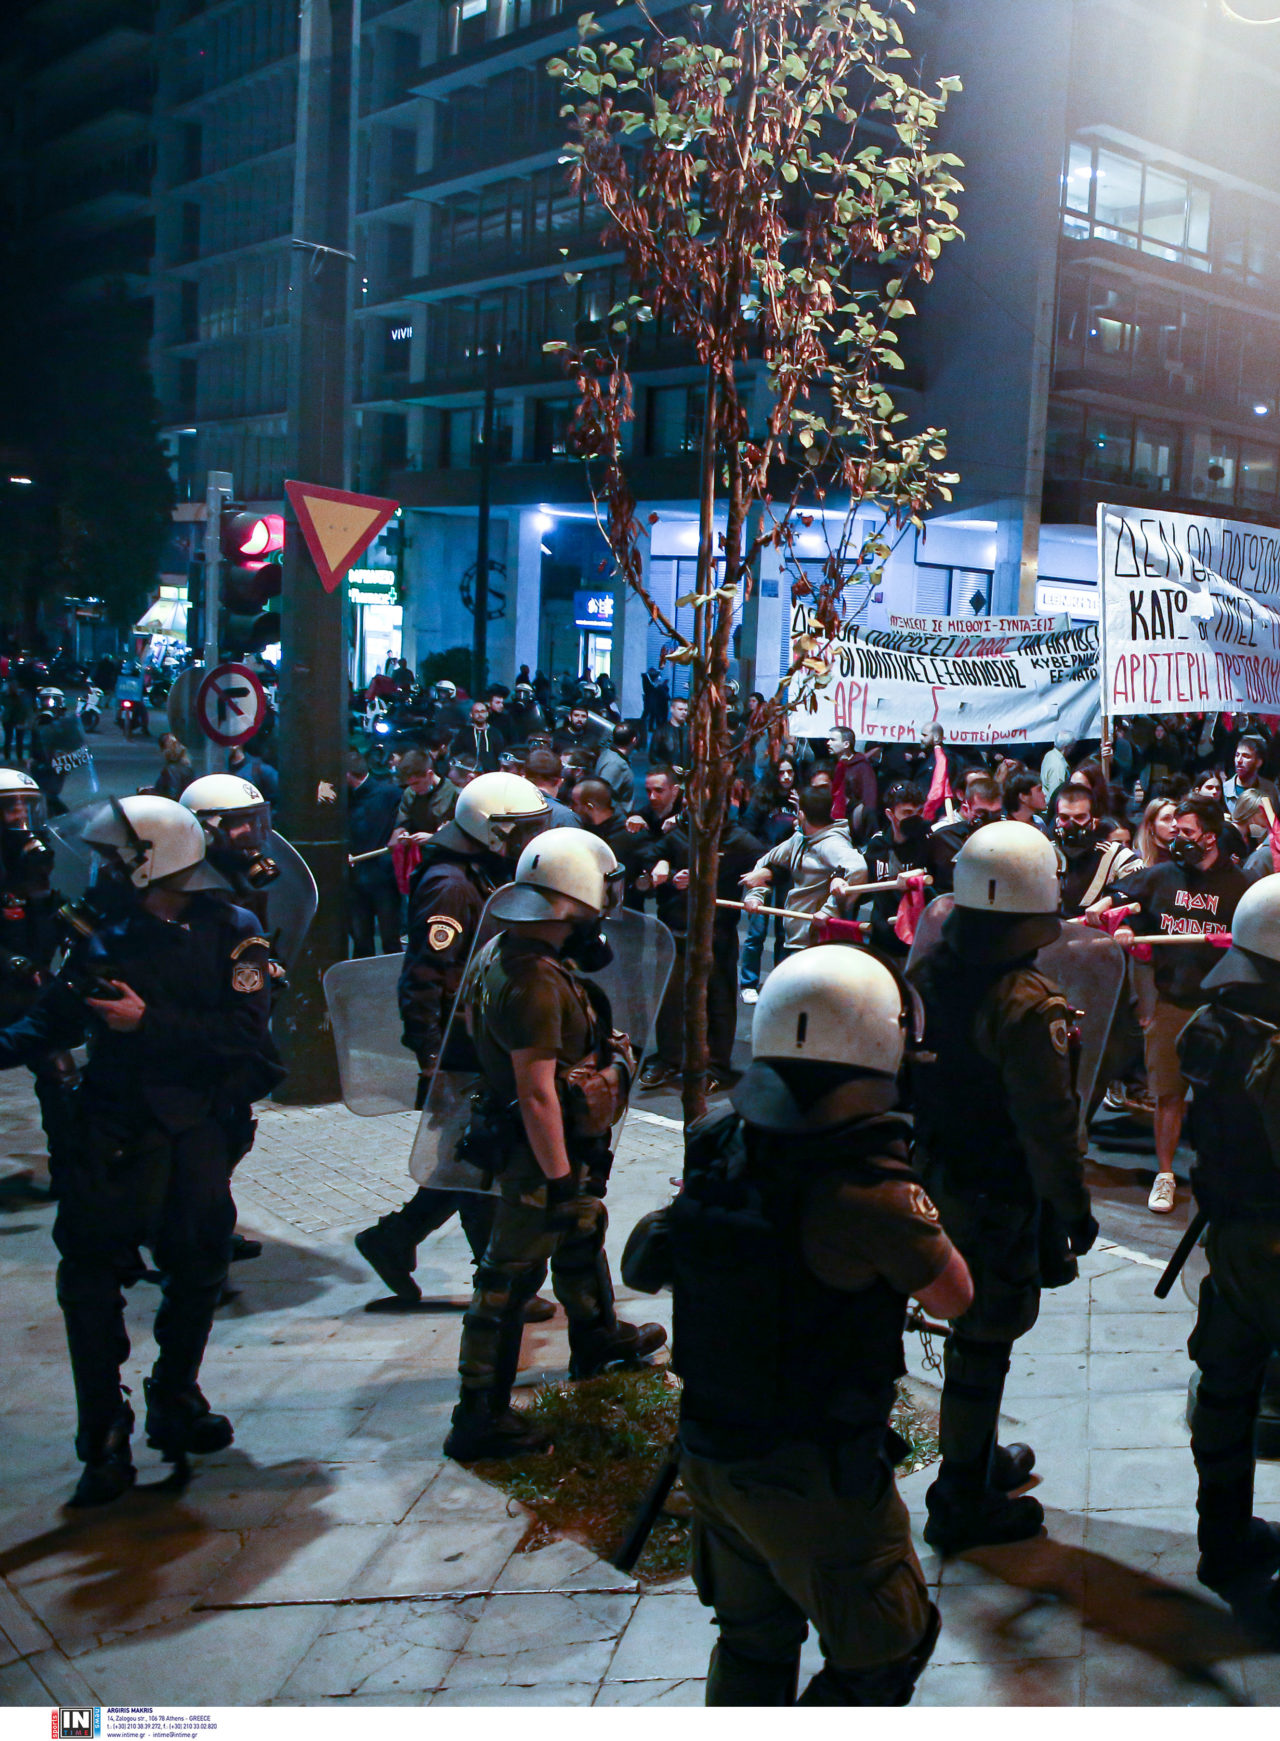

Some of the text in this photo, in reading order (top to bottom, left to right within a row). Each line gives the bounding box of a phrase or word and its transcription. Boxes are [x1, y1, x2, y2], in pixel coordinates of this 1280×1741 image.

[1114, 517, 1184, 578] ΔΕΝ
[1187, 524, 1218, 582] ΘΑ
[932, 619, 943, 633] ΣΕ
[1129, 588, 1190, 641] ΚΑΤΩ
[1210, 592, 1258, 648] ΤΙΜΕΣ
[865, 629, 957, 658] ΠΛΗΡΩΣΕΙ
[1045, 624, 1099, 656] ΑΚΡΙΒΕΙ
[855, 647, 936, 685] ΠΟΛΙΤΙΚΕΣ
[930, 658, 1027, 689] ΕΞΑΘΛΙΩΣΗΣ
[1113, 651, 1210, 705] ΑΡΙΣΤΕΡΗ
[1174, 889, 1220, 916] IRON
[1160, 912, 1227, 936] MAIDEN
